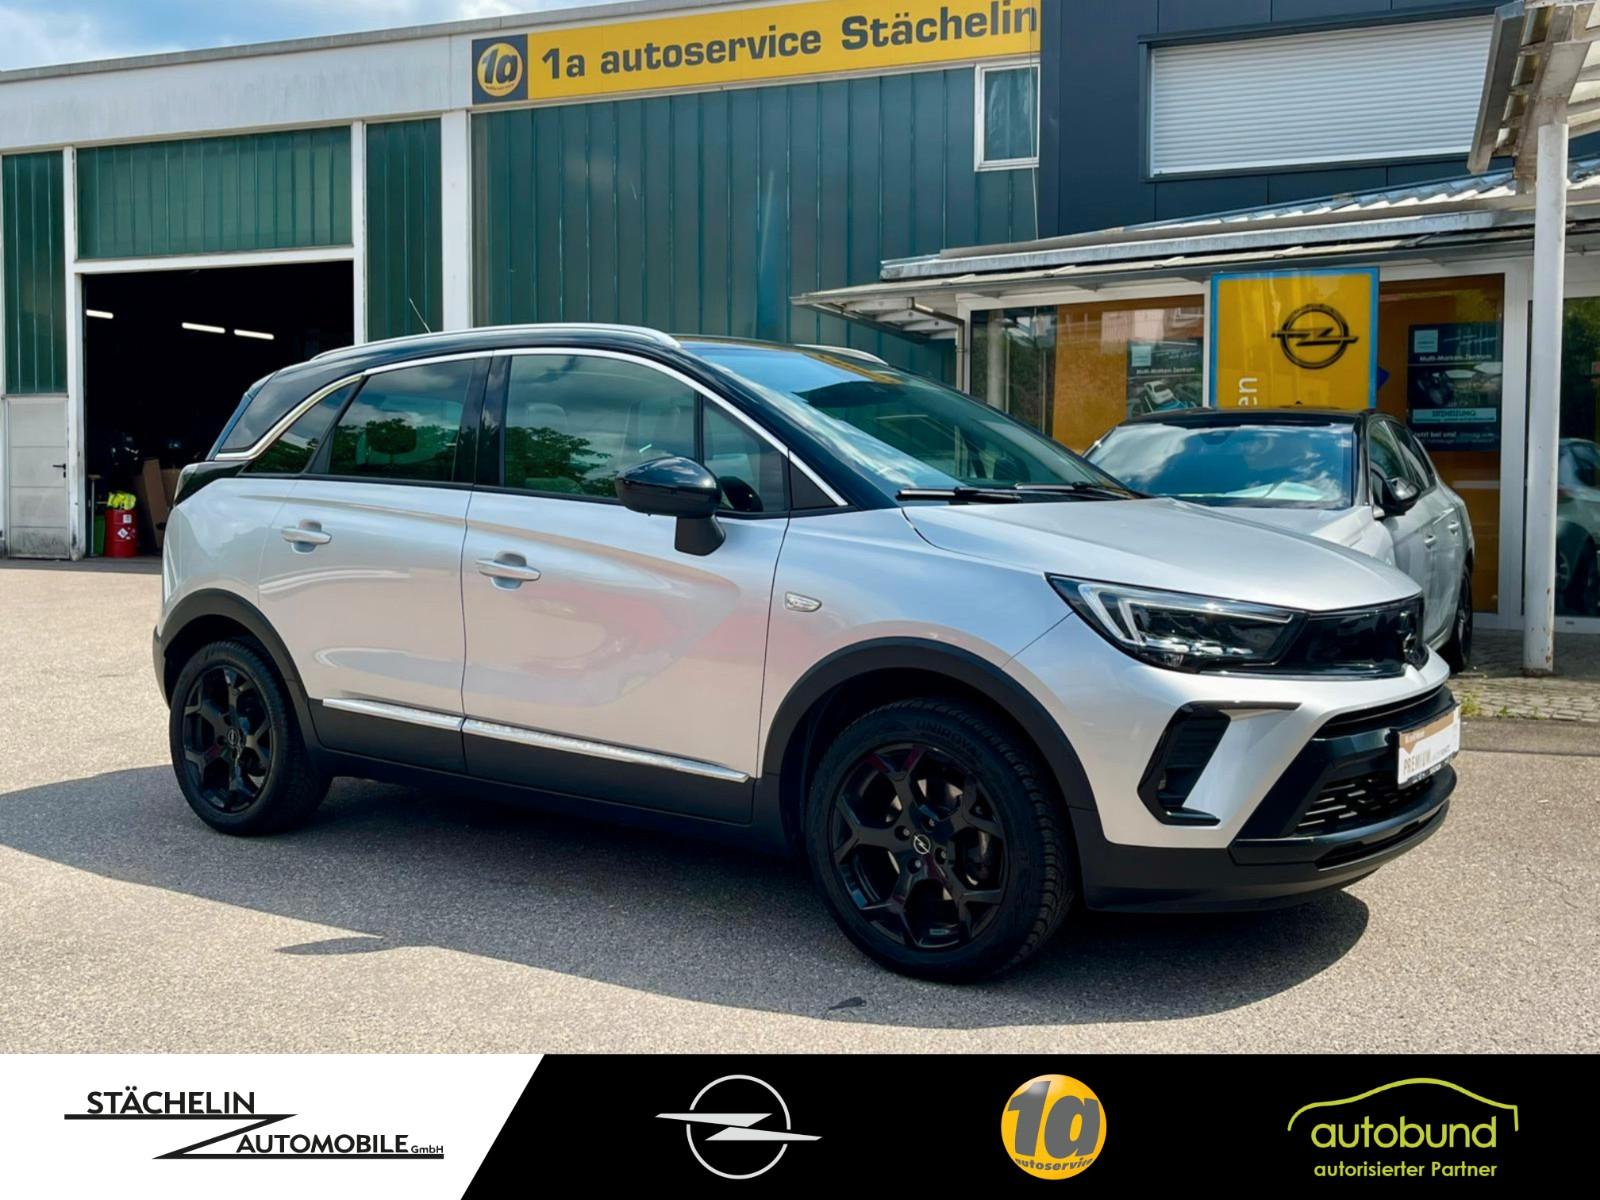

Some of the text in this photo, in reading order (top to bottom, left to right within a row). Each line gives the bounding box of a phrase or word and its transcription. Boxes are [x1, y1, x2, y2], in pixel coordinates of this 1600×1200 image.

[482, 48, 518, 84] 1a
[542, 0, 1037, 79] 1a autoservice Stächelin
